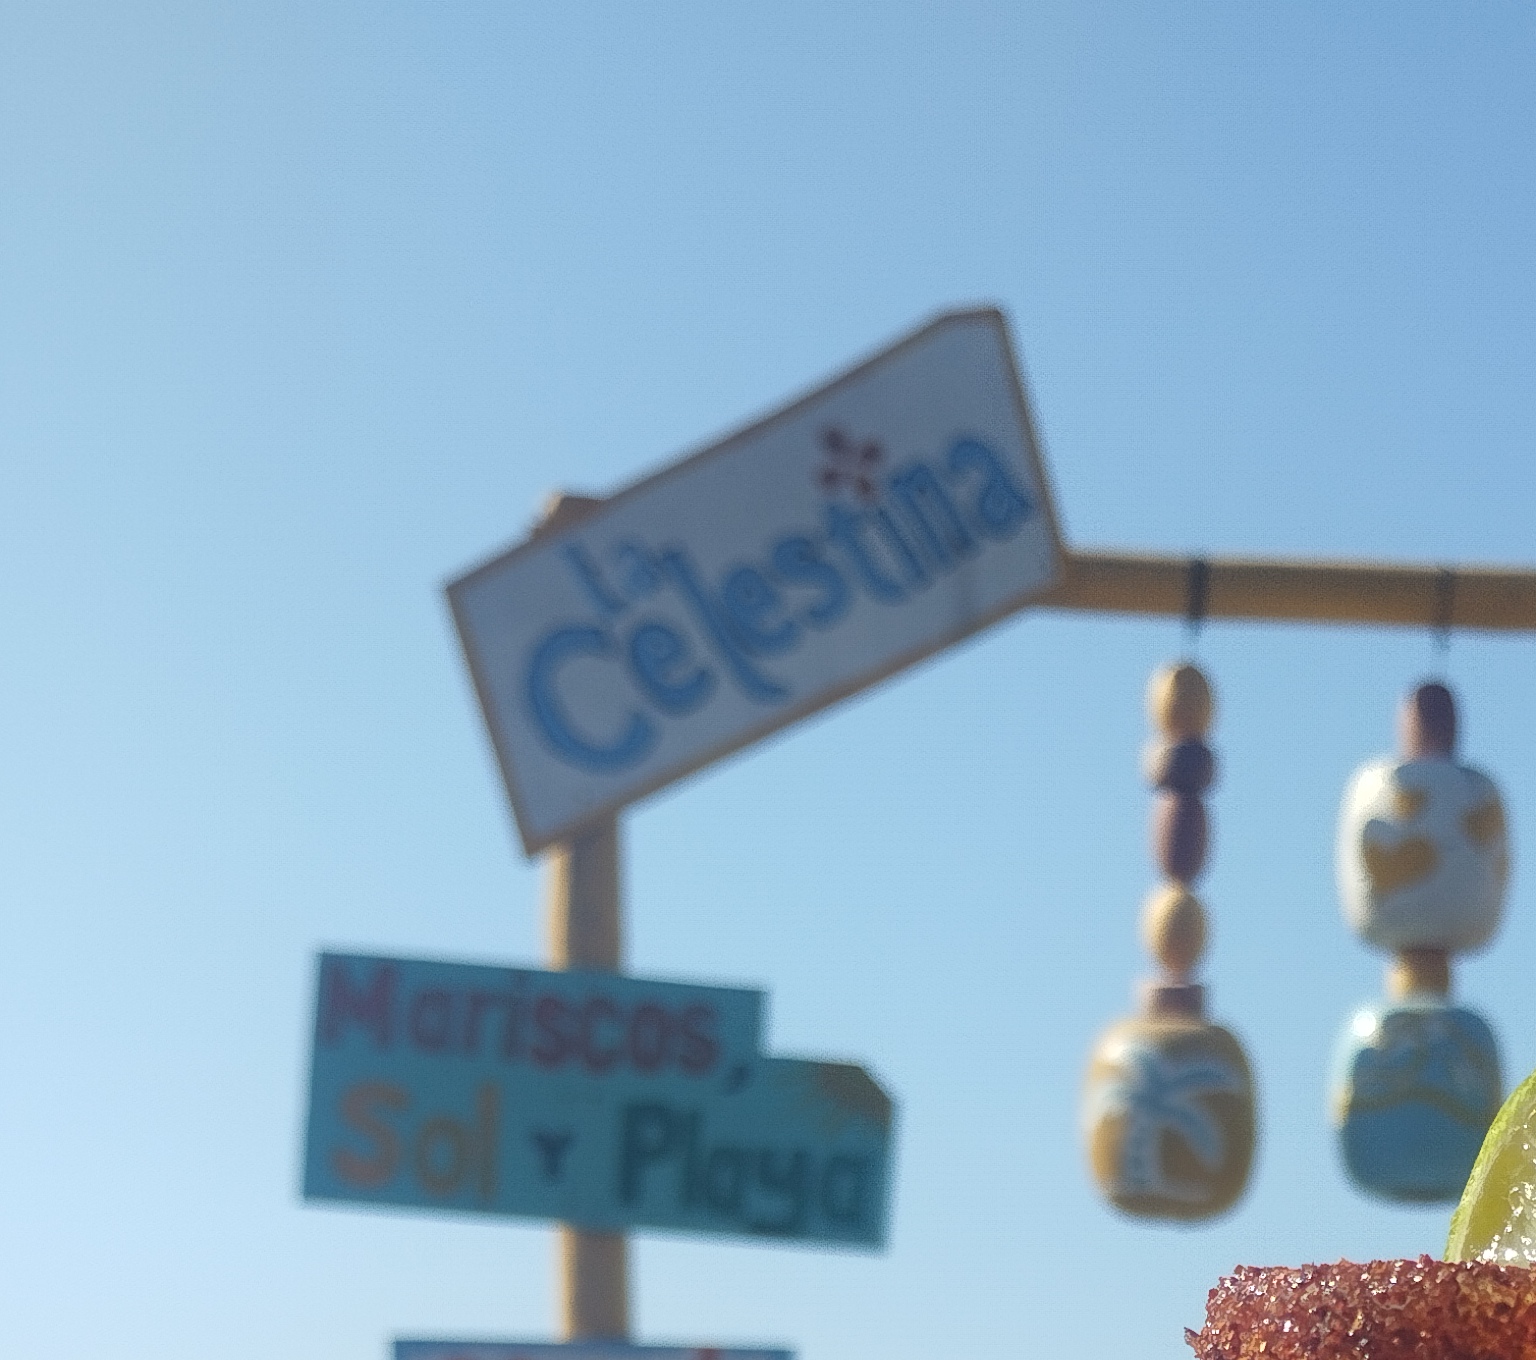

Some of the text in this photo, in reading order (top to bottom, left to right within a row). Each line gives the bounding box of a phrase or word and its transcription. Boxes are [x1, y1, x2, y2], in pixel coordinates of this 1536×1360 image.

[524, 436, 1036, 774] Celestina
[329, 1076, 502, 1208] Sol
[618, 1100, 874, 1238] Playa
